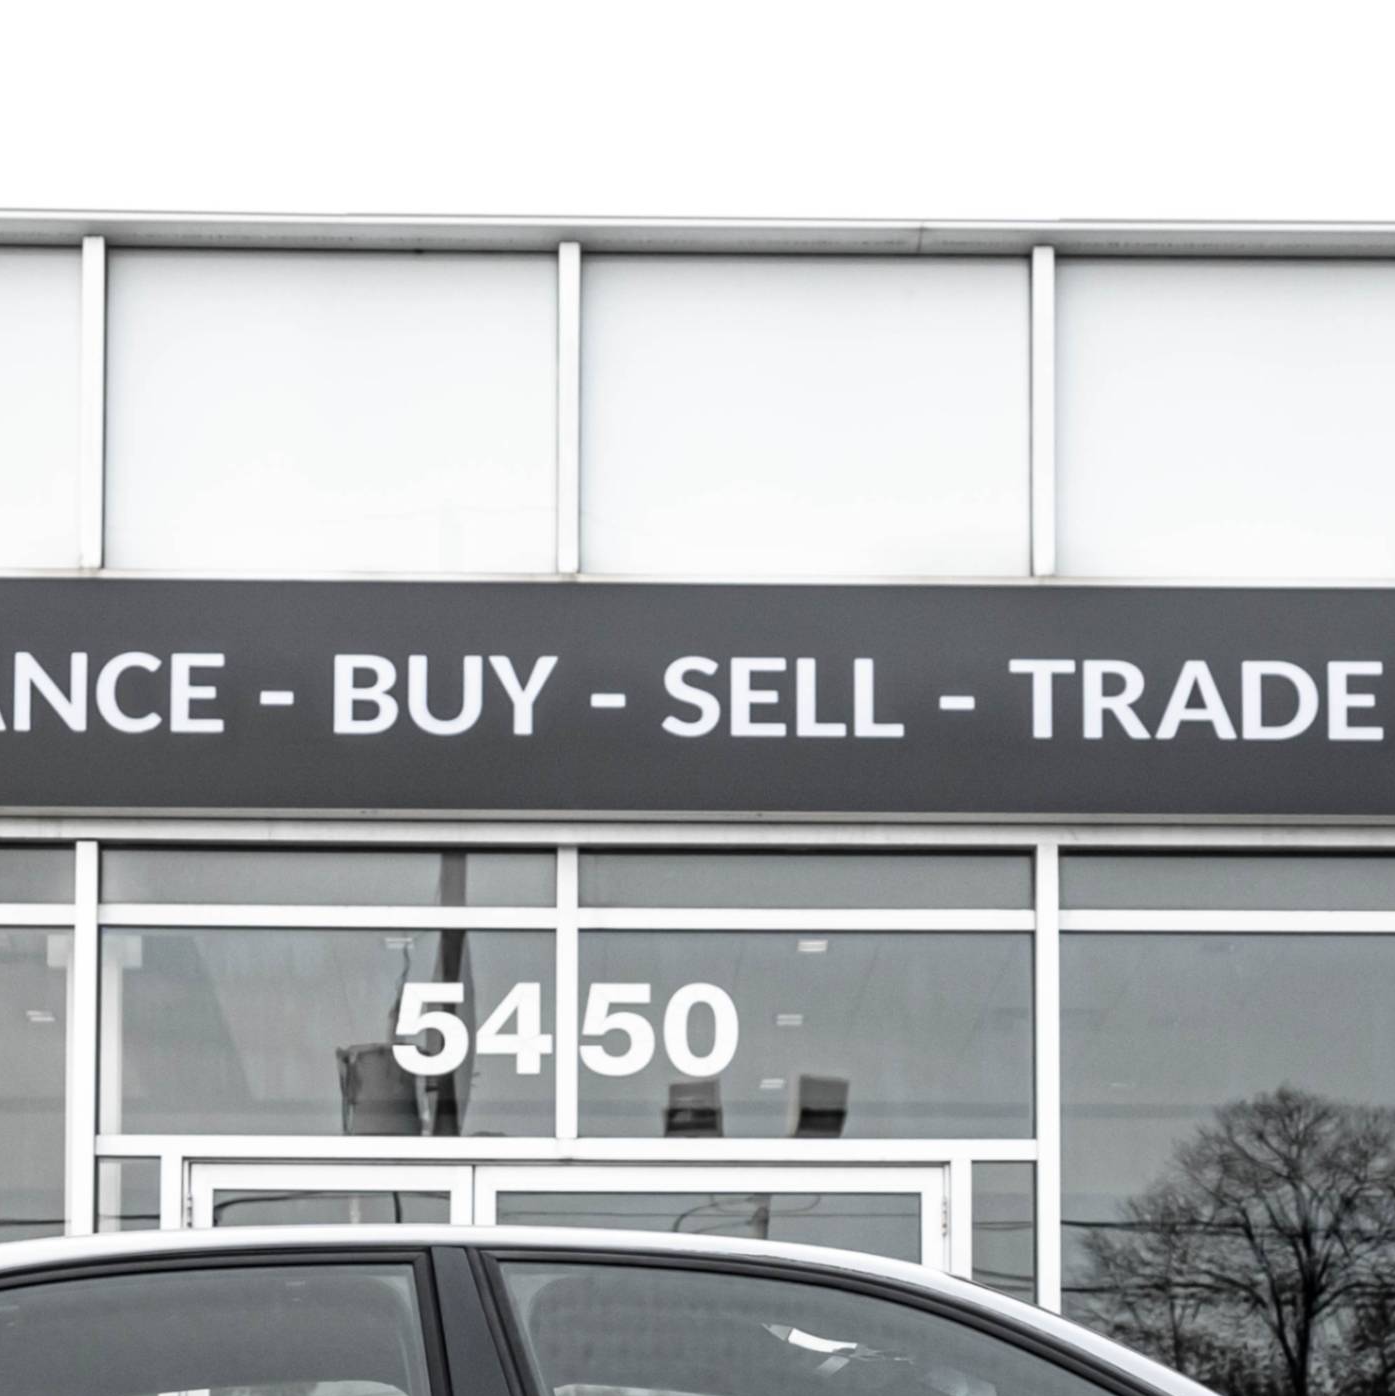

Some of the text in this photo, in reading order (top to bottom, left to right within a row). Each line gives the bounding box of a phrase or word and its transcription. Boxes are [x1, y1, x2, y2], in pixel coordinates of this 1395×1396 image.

[332, 653, 560, 736] BUY
[661, 655, 906, 739] SELL
[1007, 658, 1385, 742] TRADE
[392, 981, 740, 1078] 5450
